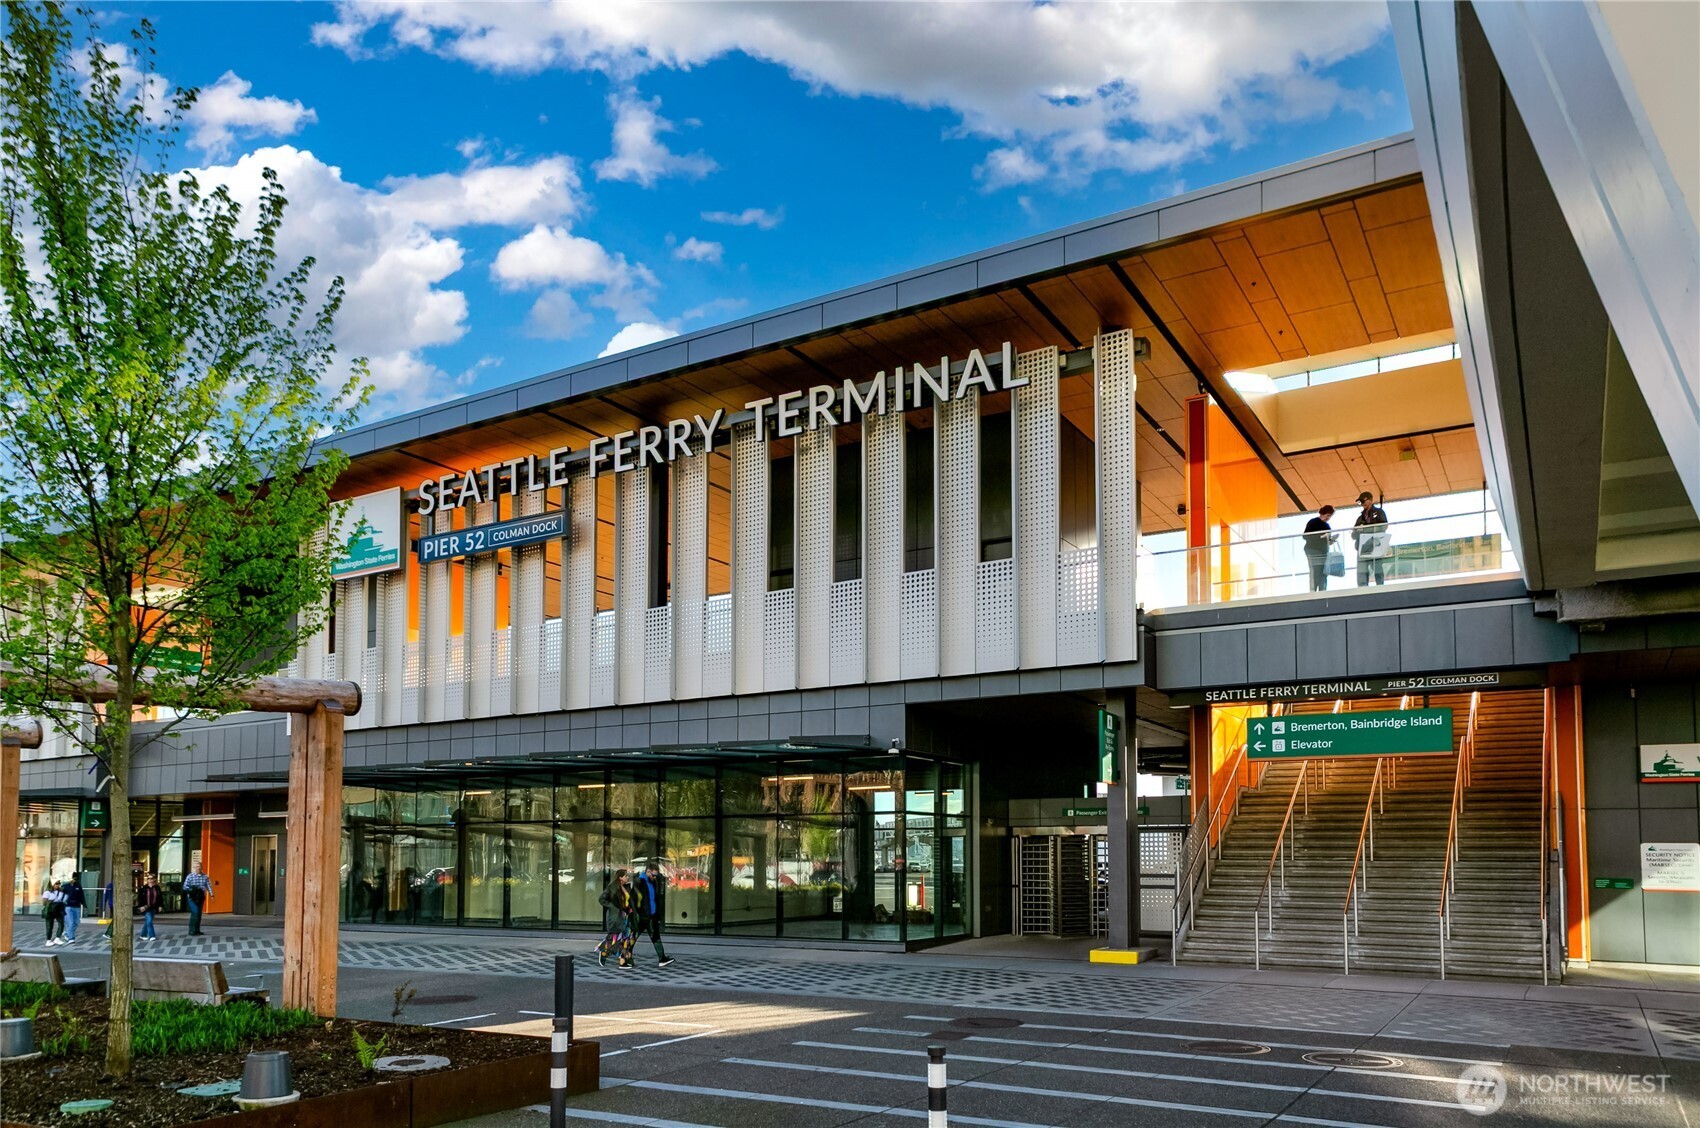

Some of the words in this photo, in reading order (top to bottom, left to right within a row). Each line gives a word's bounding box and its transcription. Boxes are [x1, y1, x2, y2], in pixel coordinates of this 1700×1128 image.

[418, 446, 570, 515] SEATTLE
[589, 407, 726, 478] FERRY
[744, 341, 1030, 442] TERMINAL
[493, 525, 530, 542] COLMAN
[532, 520, 558, 534] DOCK
[424, 536, 460, 559] PIER
[465, 530, 485, 551] 52
[335, 559, 364, 570] Washington
[364, 556, 378, 565] State
[378, 552, 396, 562] Ferries
[1387, 679, 1406, 688] PIER
[1408, 677, 1425, 688] 52
[1430, 677, 1466, 686] COLMAN
[1469, 674, 1495, 683] DOCK
[1205, 688, 1257, 701] SEATTLE
[1260, 684, 1298, 698] FERRY
[1303, 681, 1371, 695] TERMINAL
[1290, 719, 1348, 733] Bremerton,
[1350, 717, 1408, 731] Bainbridge
[1410, 715, 1443, 728] Island
[1291, 738, 1333, 750] Elevator
[1076, 808, 1098, 816] Passenger
